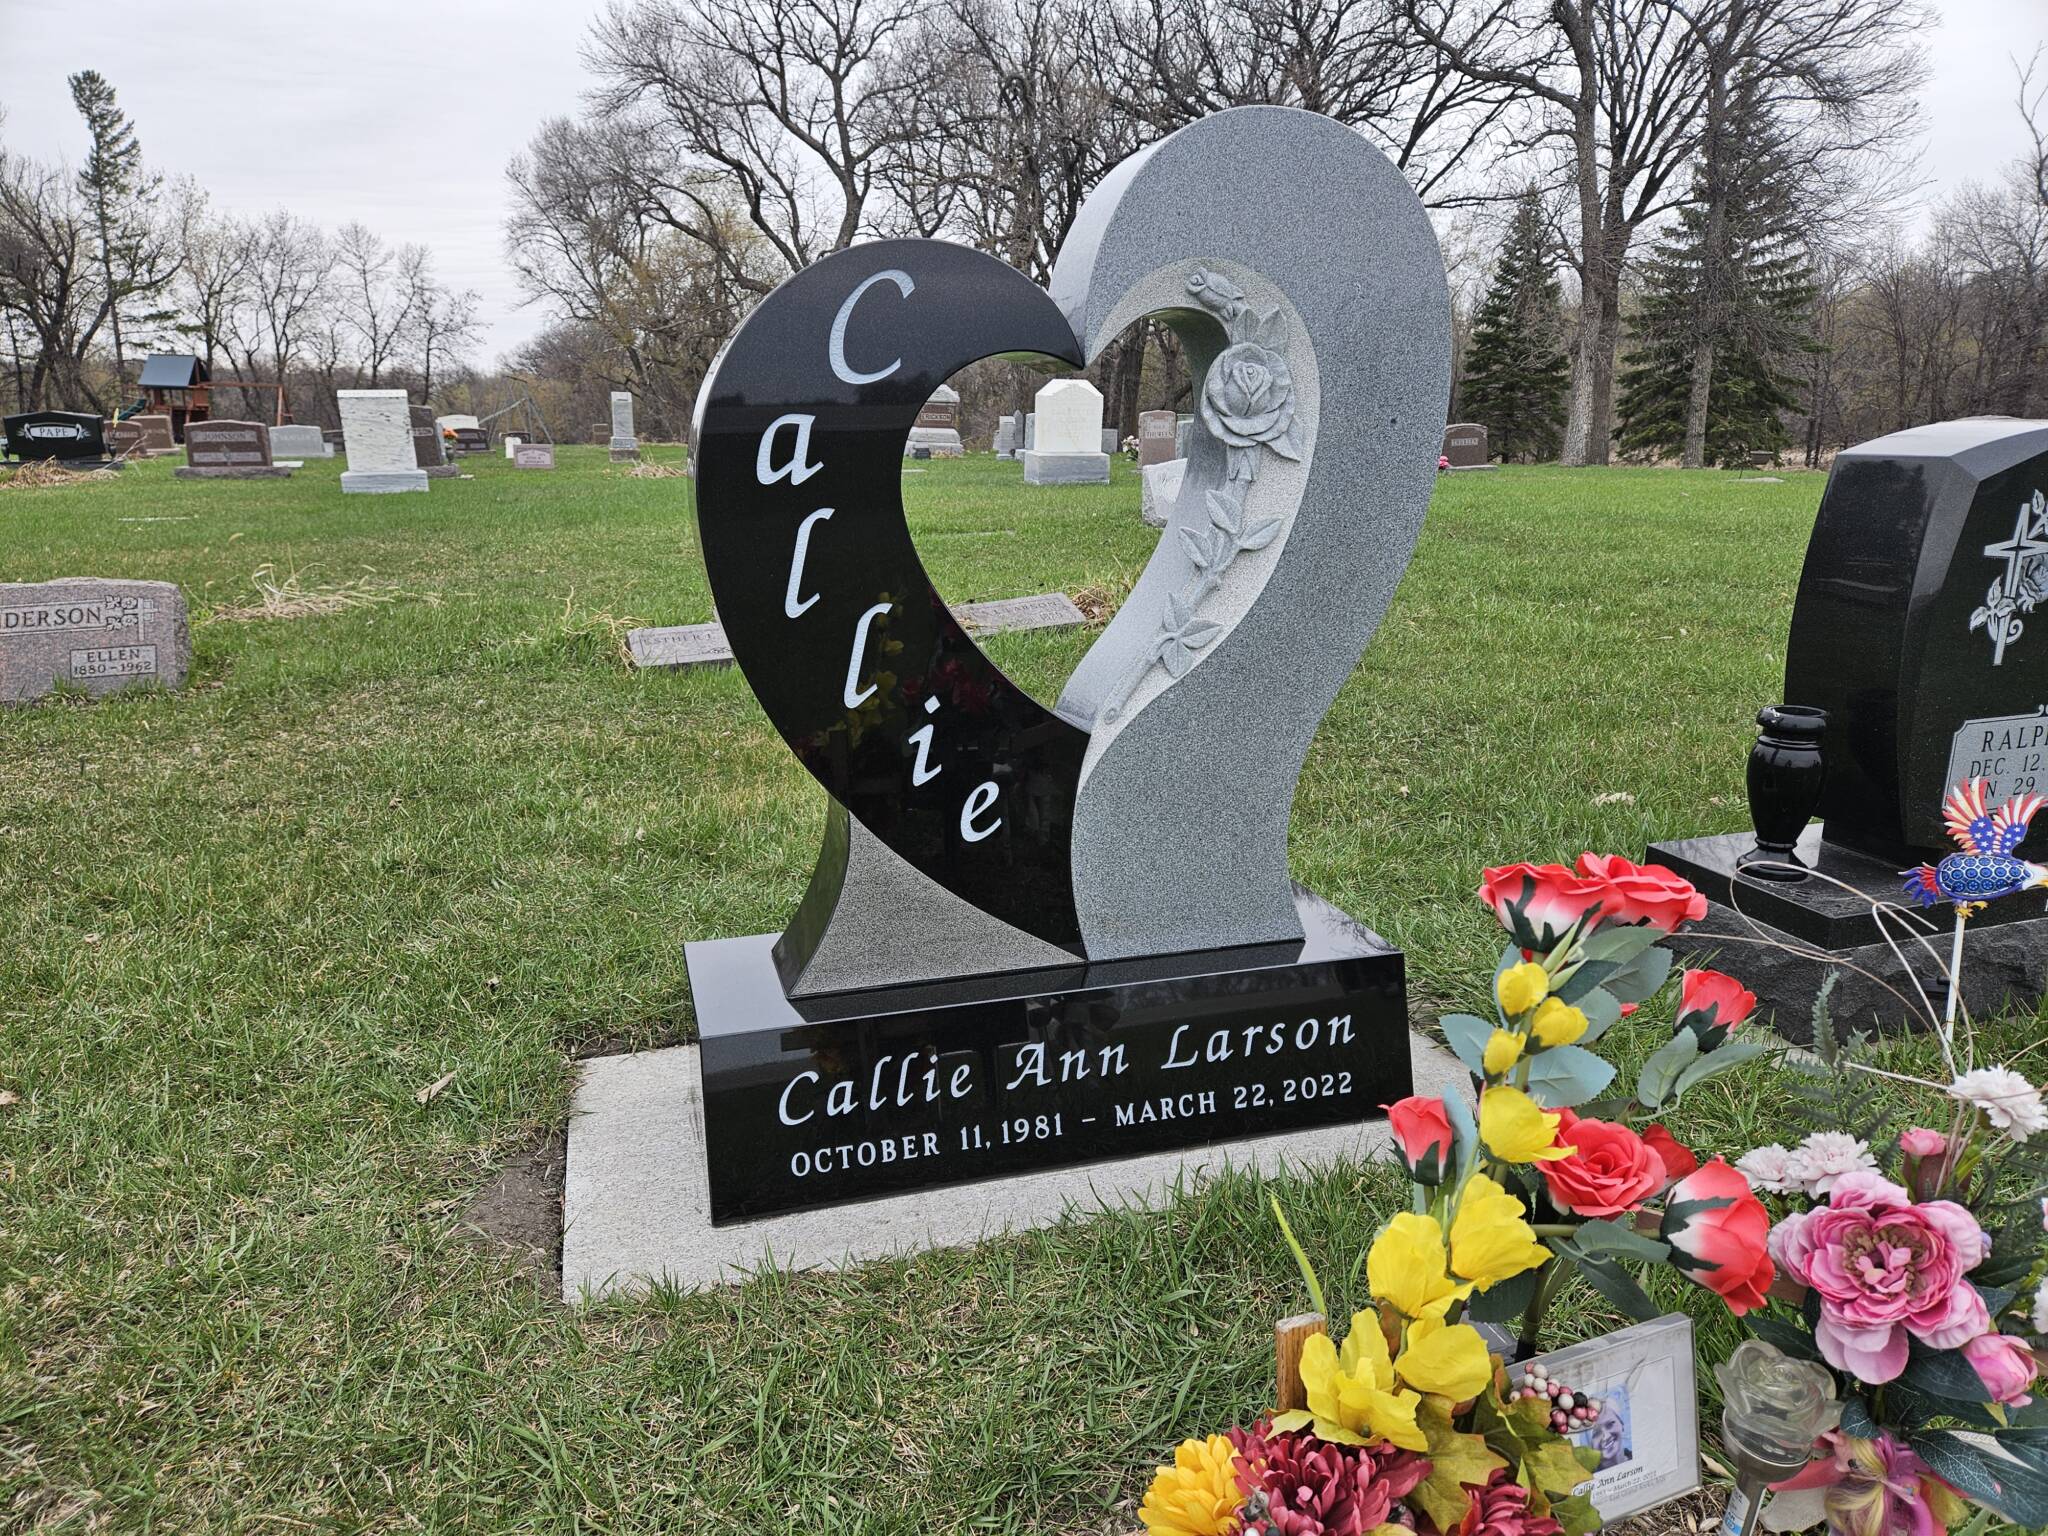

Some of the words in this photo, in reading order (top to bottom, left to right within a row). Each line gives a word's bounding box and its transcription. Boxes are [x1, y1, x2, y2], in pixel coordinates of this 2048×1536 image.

[39, 427, 69, 437] PAPE
[203, 431, 247, 441] JOHNSON
[756, 269, 1001, 842] Callie
[0, 606, 102, 629] DERSON
[86, 648, 141, 663] ELLEN
[1968, 757, 2010, 779] DEC.
[778, 1052, 974, 1127] Callie
[1006, 1041, 1130, 1091] Ann
[1160, 1014, 1356, 1070] Larson
[790, 1132, 941, 1178] OCTOBER
[1114, 1091, 1217, 1127] MARCH
[1597, 1477, 1615, 1489] Ann
[1616, 1465, 1644, 1481] Larson
